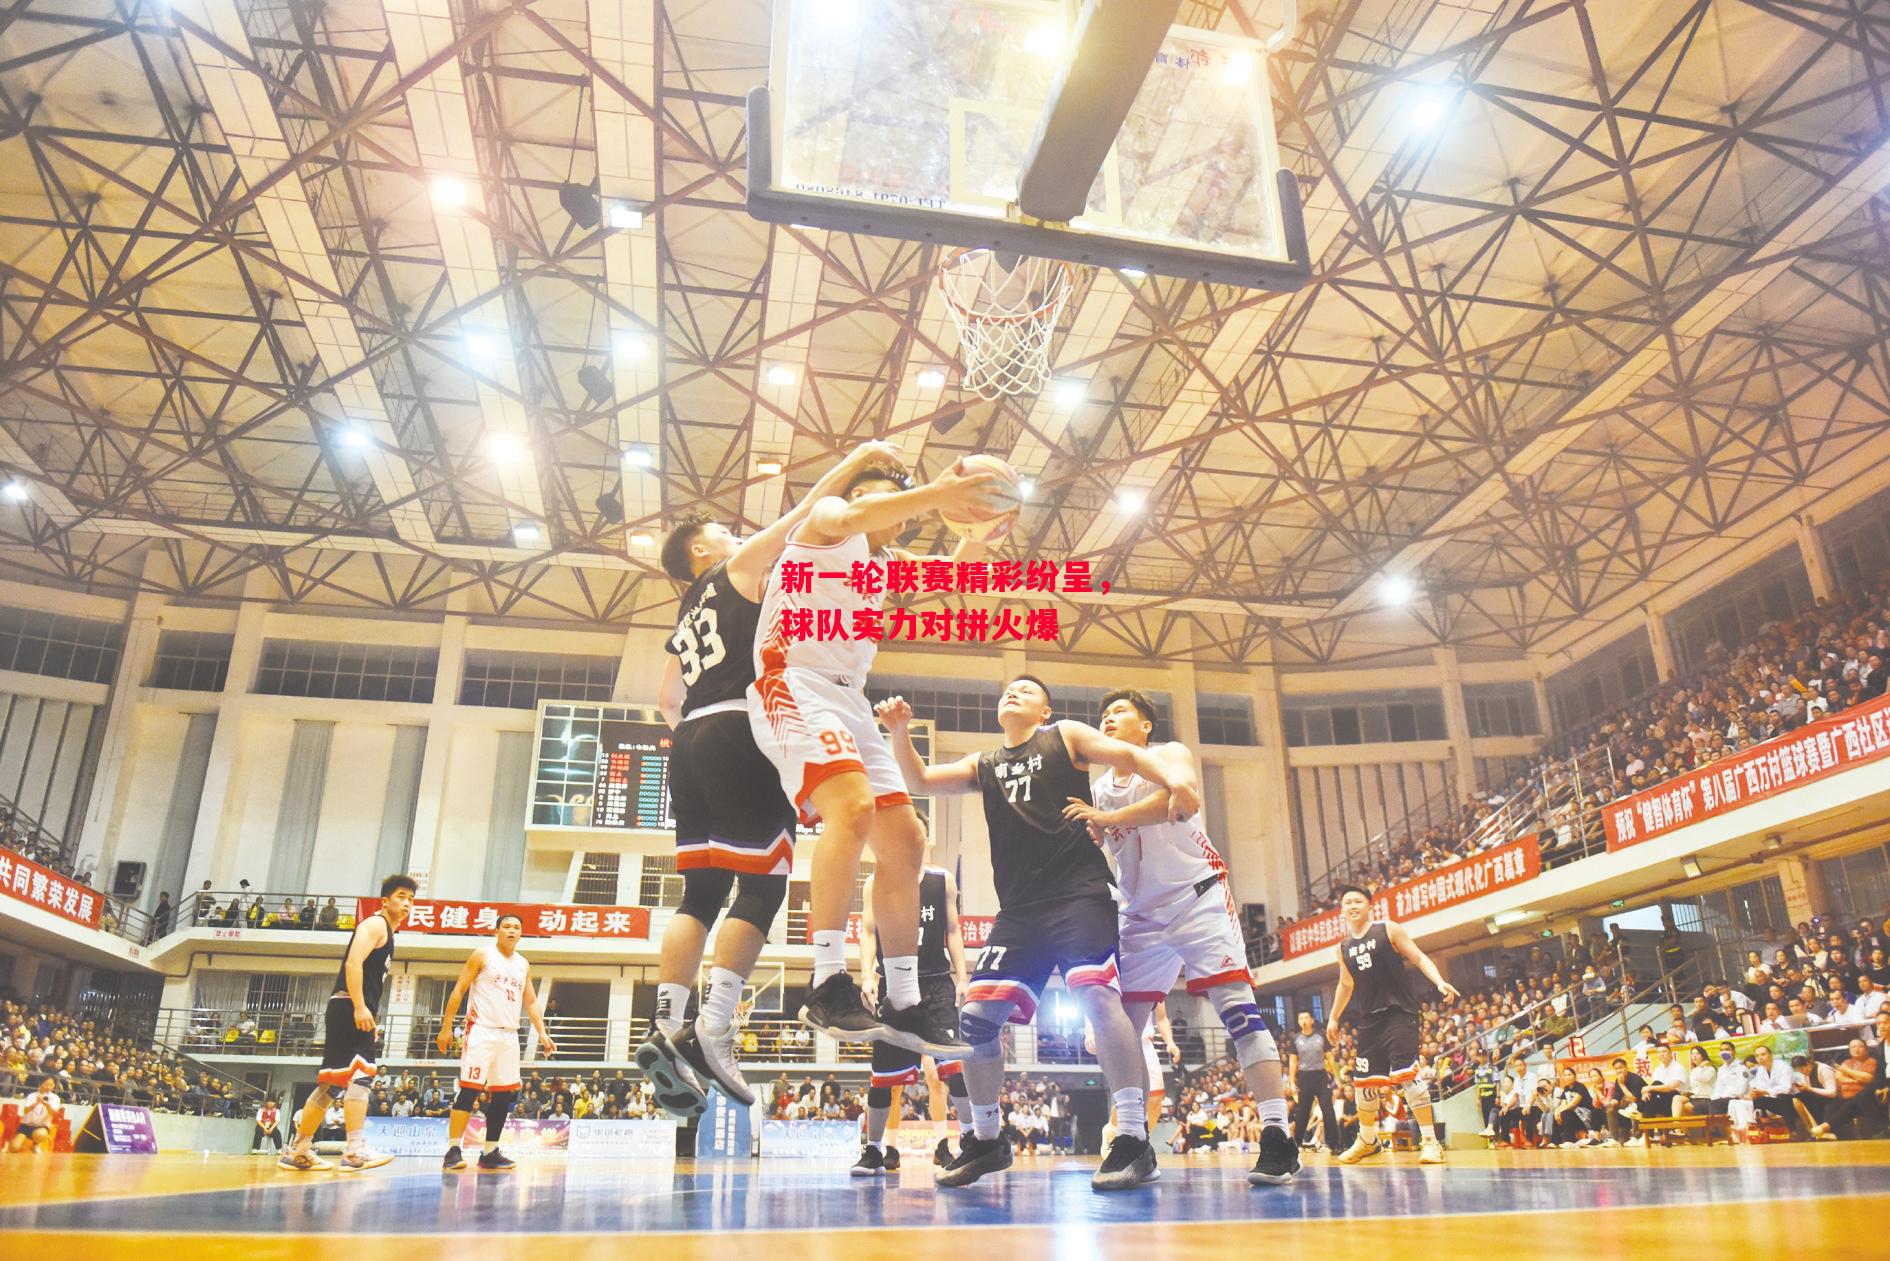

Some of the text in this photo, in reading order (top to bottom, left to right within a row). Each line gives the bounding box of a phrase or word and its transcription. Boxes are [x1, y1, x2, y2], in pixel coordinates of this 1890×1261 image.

[671, 607, 727, 687] 33
[818, 729, 858, 756] 99
[1004, 774, 1032, 803] 77
[0, 855, 94, 923] 共同繁荣发展
[538, 909, 632, 934] 动起来
[975, 945, 1007, 971] 77
[1355, 952, 1373, 971] 59
[467, 1066, 481, 1080] 13
